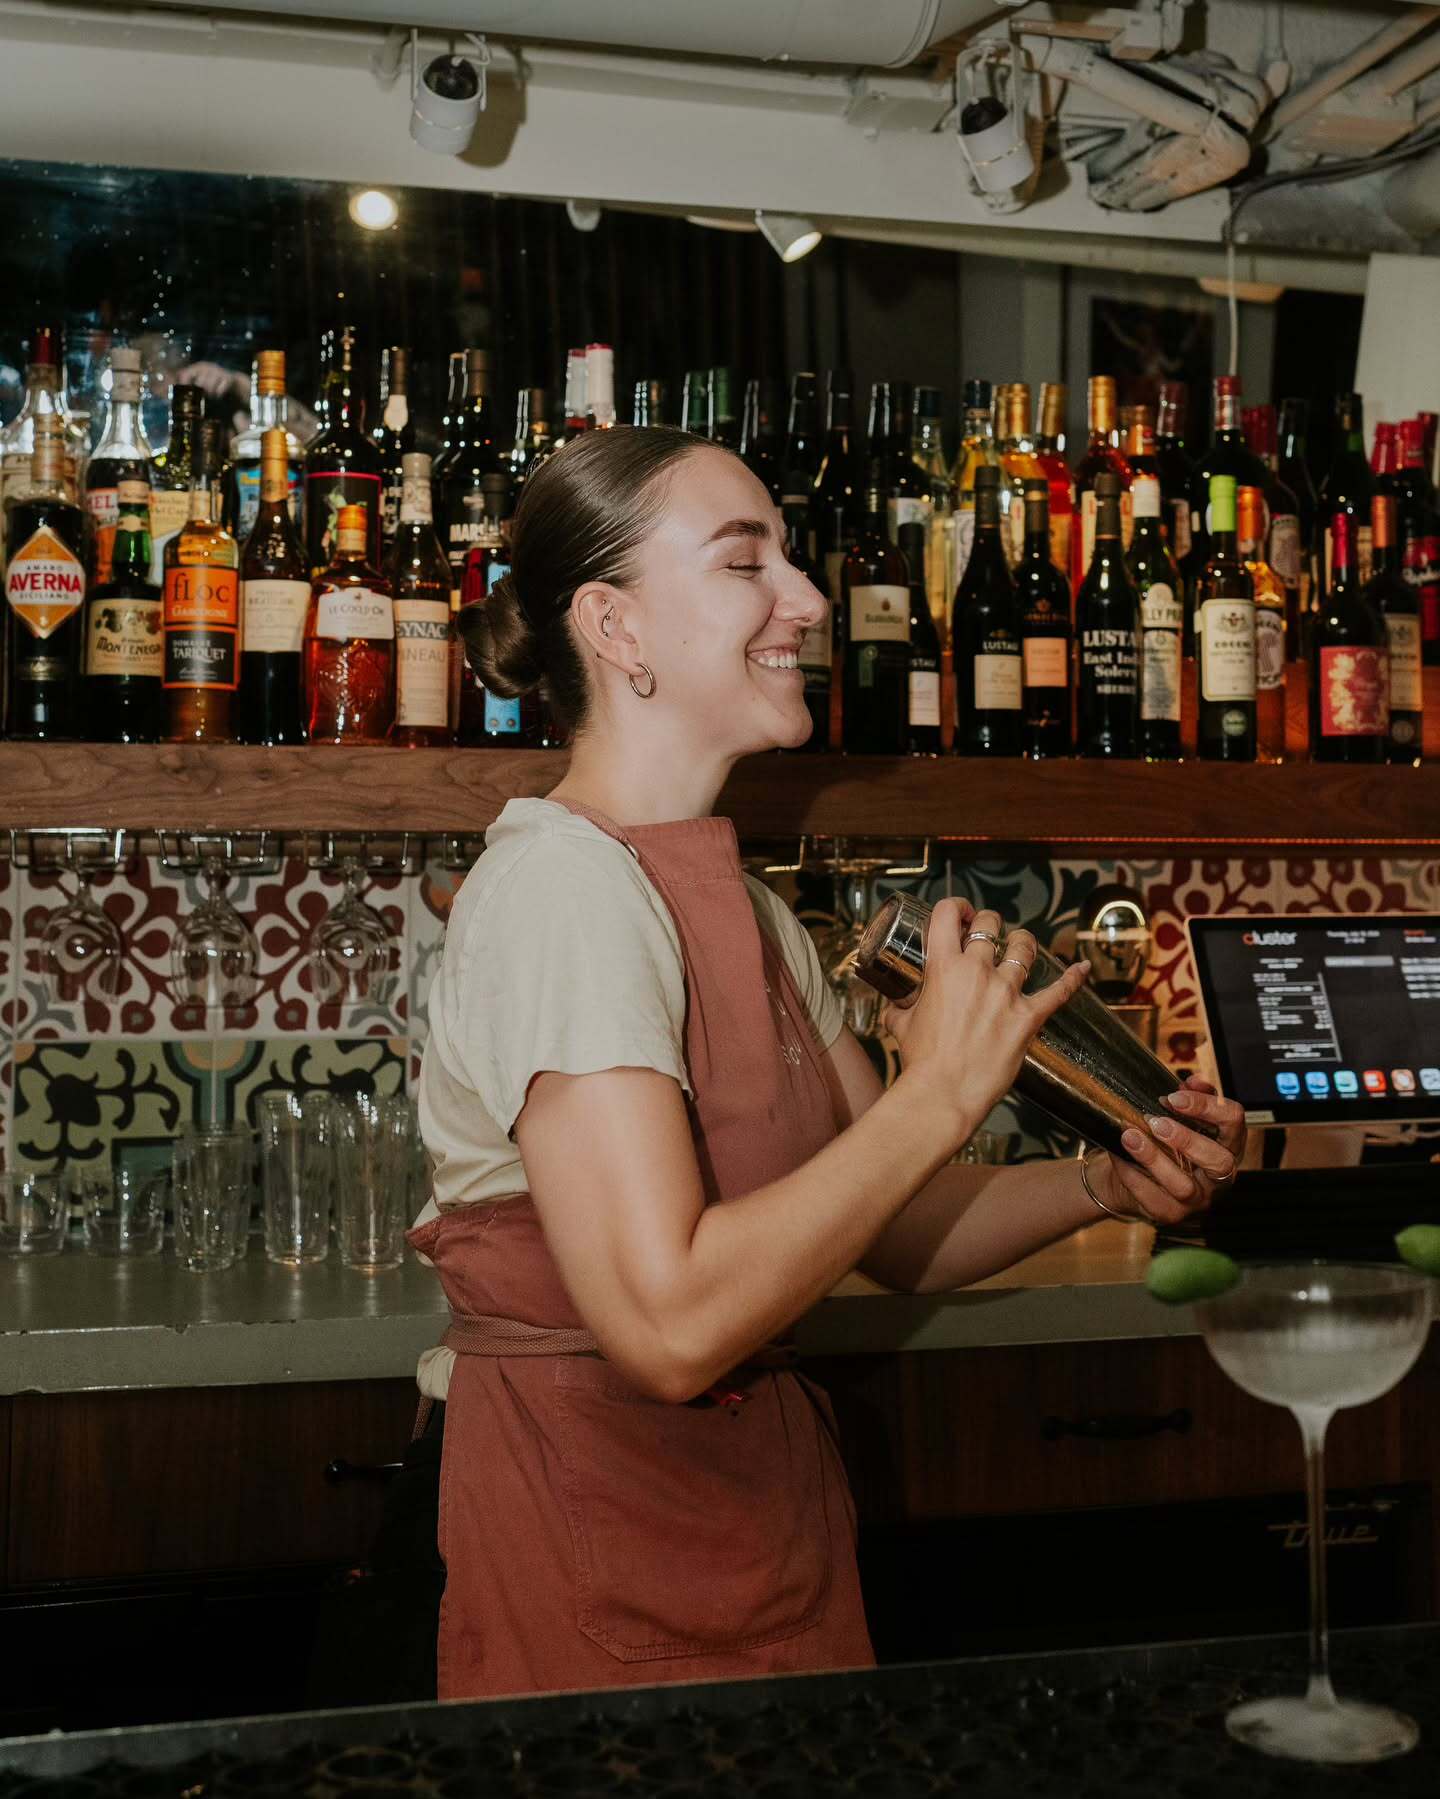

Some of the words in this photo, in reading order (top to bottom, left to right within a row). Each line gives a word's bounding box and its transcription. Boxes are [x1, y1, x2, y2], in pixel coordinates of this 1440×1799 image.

[9, 572, 82, 593] AVERNA
[1083, 630, 1136, 647] LUSTA
[173, 648, 226, 662] TARIQUET
[1083, 652, 1112, 664] East
